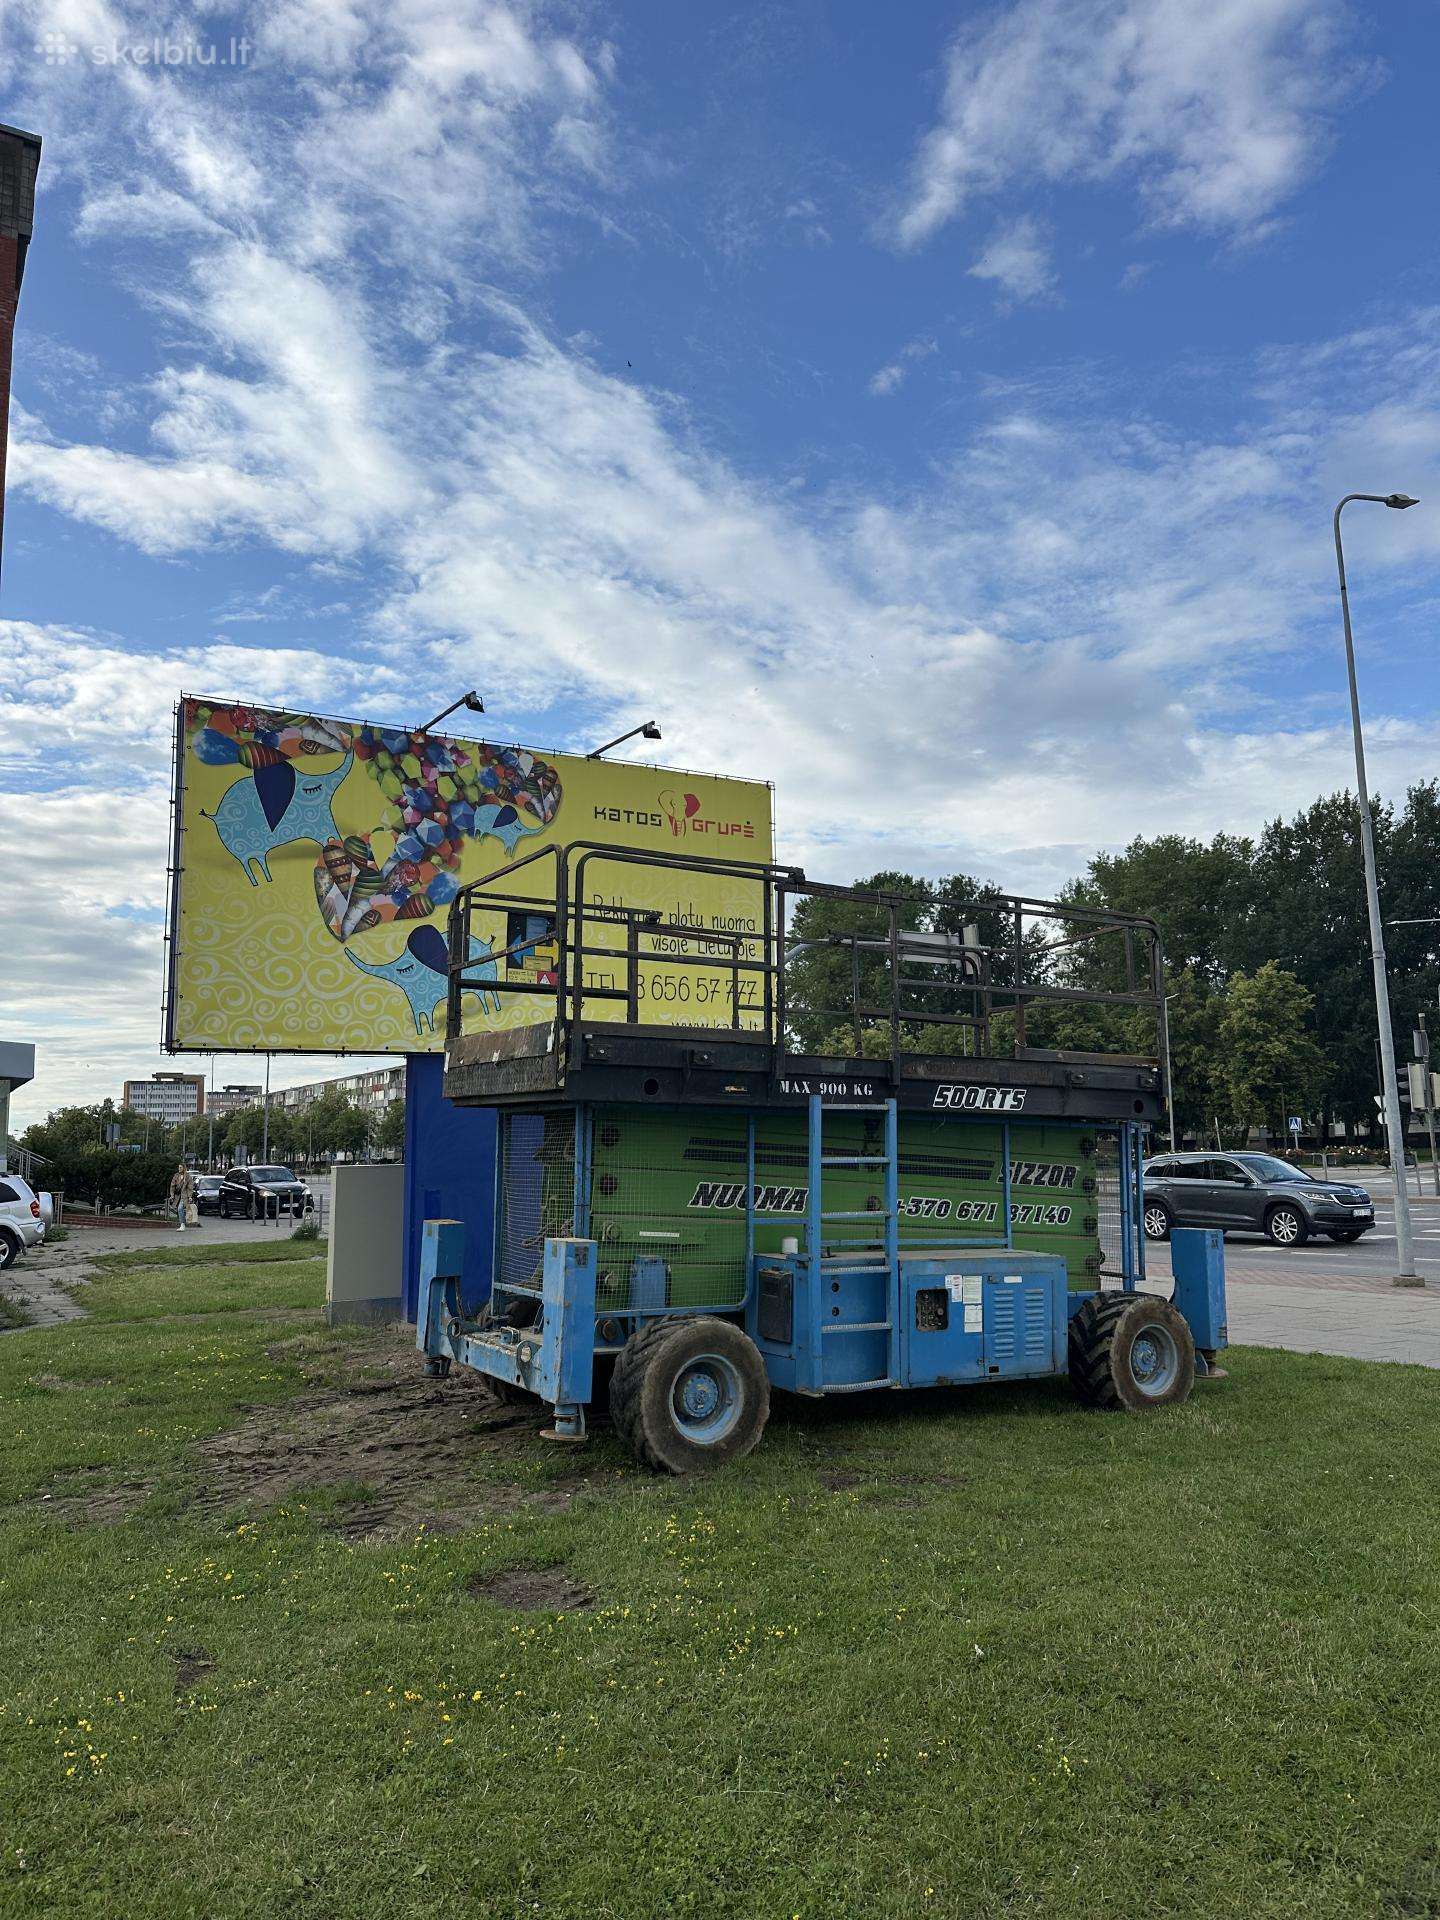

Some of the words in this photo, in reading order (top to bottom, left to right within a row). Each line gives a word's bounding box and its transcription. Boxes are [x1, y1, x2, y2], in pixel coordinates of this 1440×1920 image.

[712, 915, 756, 932] nuoma
[651, 934, 689, 956] visoje
[651, 974, 691, 1002] 656
[696, 977, 721, 1004] 57
[725, 979, 758, 1005] 777
[779, 1080, 811, 1094] MAX
[819, 1082, 847, 1096] 900
[853, 1083, 873, 1096] KG
[687, 1182, 809, 1214] NUOMA
[956, 1201, 998, 1222] 671
